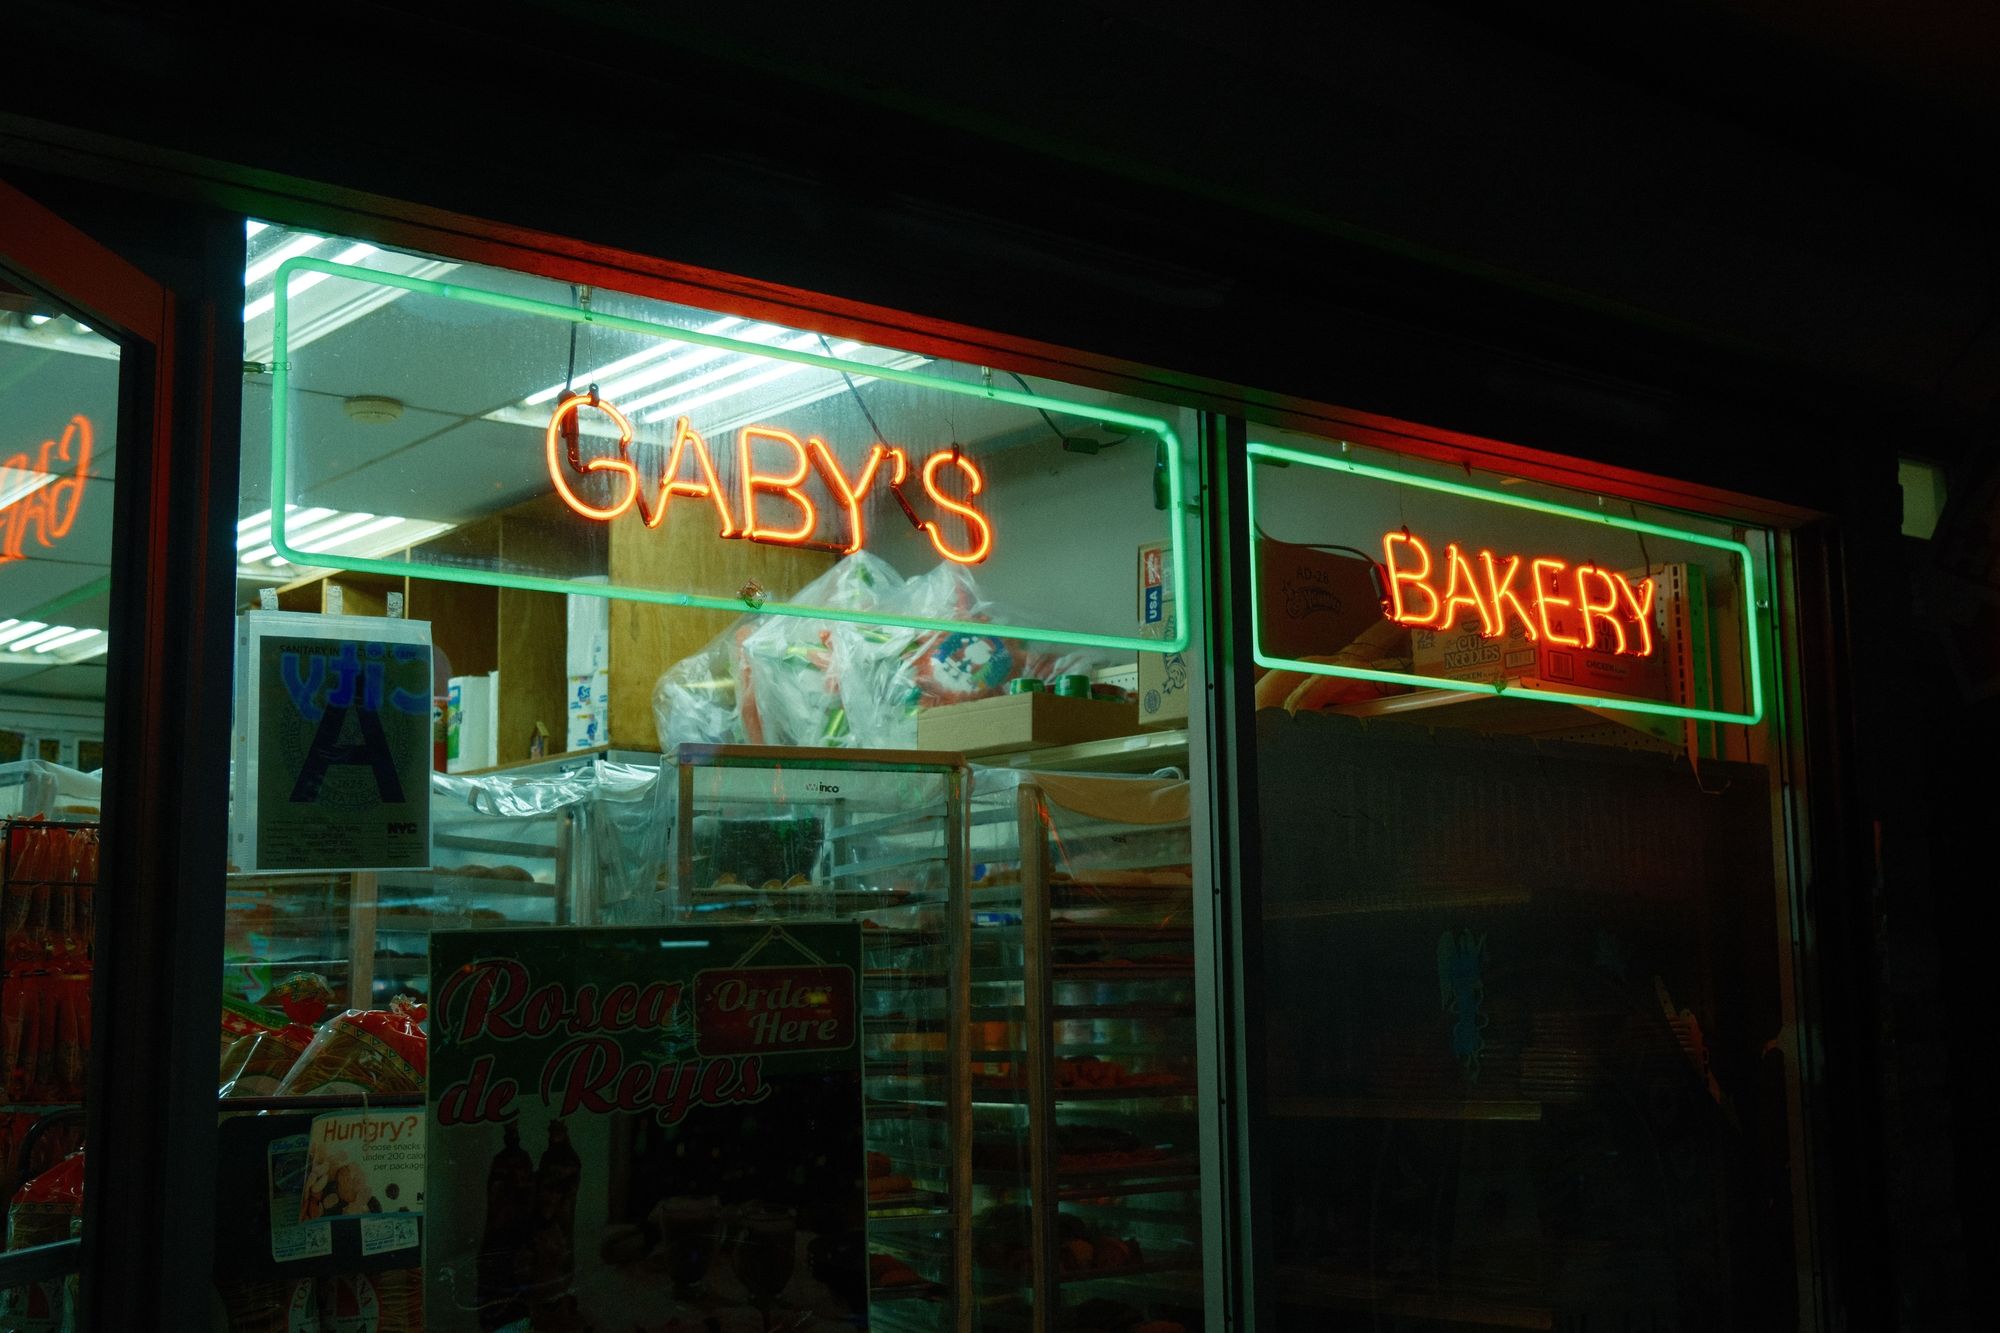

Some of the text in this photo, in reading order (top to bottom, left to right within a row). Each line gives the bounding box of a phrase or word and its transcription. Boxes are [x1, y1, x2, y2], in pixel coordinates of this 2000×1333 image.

[547, 394, 992, 564] GABY'S
[1148, 589, 1158, 620] USA
[1380, 530, 1657, 657] BAKERY
[279, 644, 326, 657] SANITARY
[1444, 644, 1501, 670] NOODLES
[289, 668, 406, 803] A
[387, 821, 417, 834] NYC
[437, 956, 690, 1043] Rosca
[712, 979, 832, 1014] Order
[747, 1012, 839, 1046] Here
[438, 1037, 772, 1127] de Reyes
[323, 1115, 419, 1143] Hungry?
[362, 1144, 394, 1153] Choose
[394, 1142, 421, 1151] snacks
[362, 1153, 387, 1162] under
[387, 1152, 406, 1161] 200
[374, 1164, 387, 1172] per
